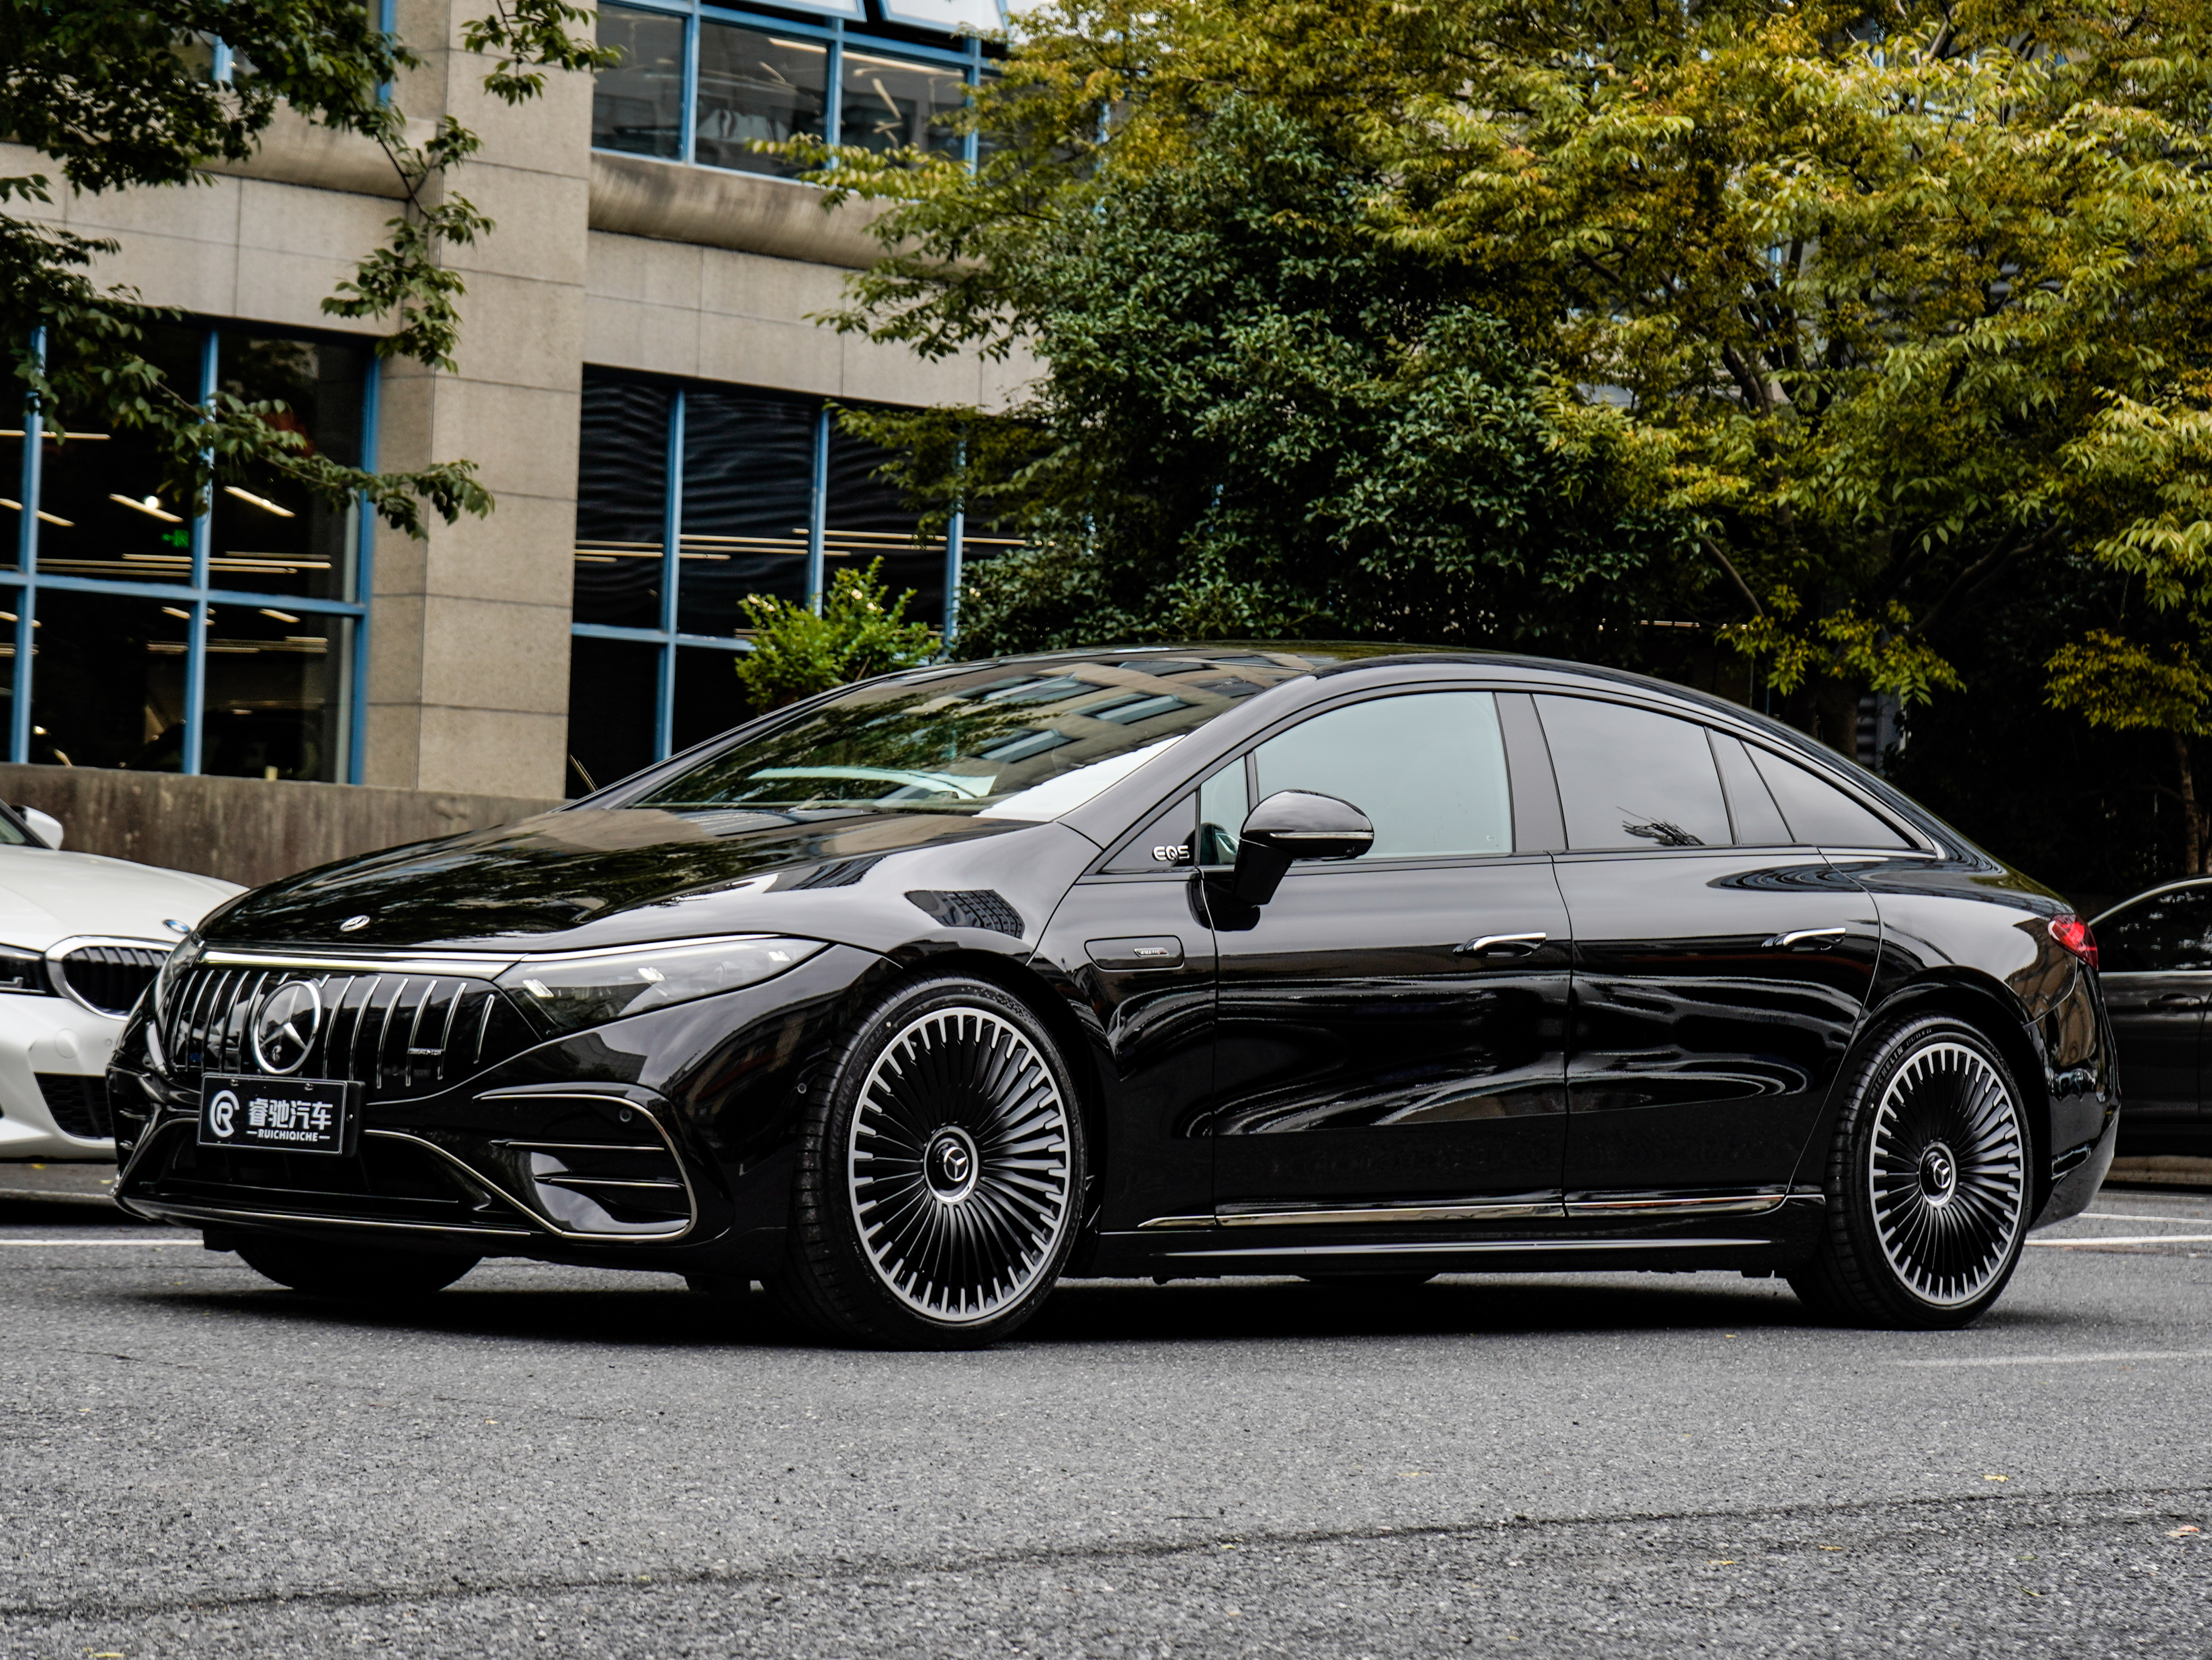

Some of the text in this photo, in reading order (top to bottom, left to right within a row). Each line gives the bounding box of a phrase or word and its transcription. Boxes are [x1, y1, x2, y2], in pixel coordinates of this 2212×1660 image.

[1153, 845, 1190, 861] EQS
[1870, 1045, 1904, 1099] MICHELIN
[248, 1097, 333, 1130] 睿驰汽车
[258, 1129, 318, 1142] RUICHIQICHE
